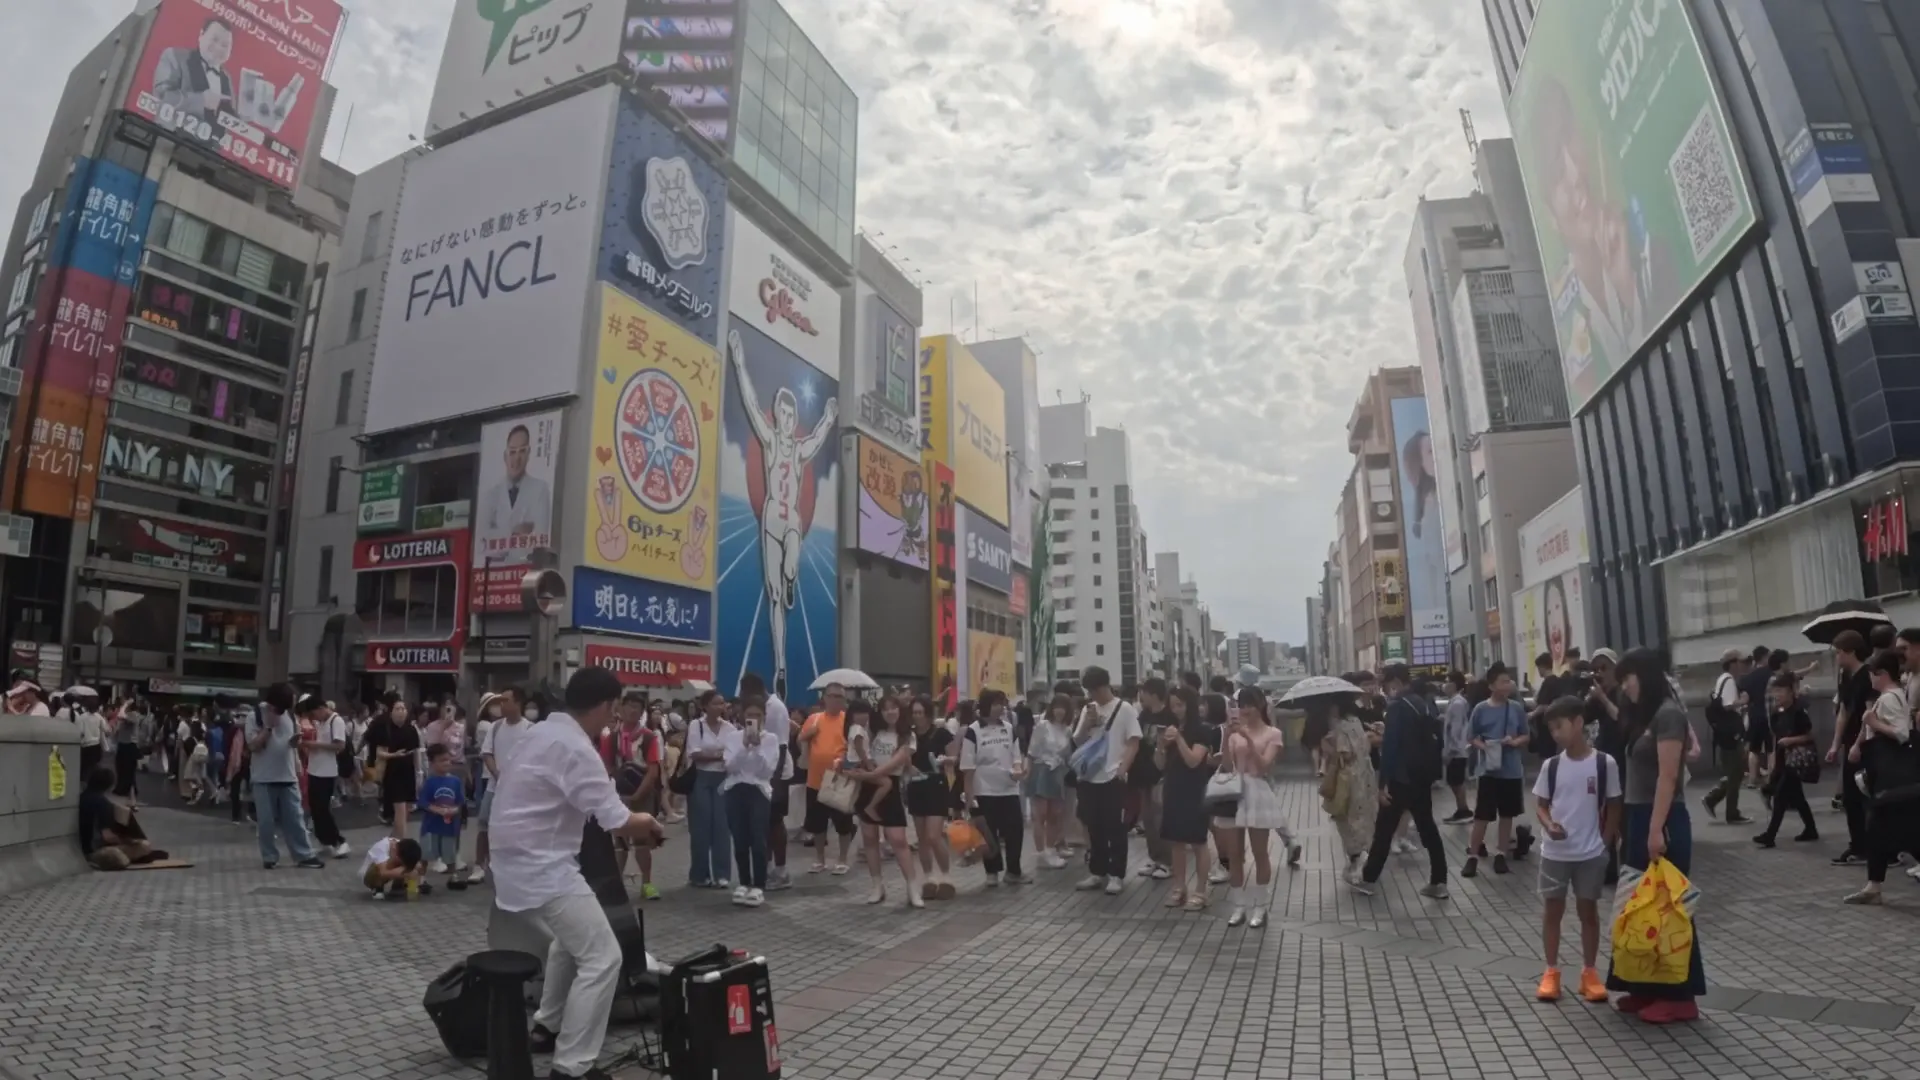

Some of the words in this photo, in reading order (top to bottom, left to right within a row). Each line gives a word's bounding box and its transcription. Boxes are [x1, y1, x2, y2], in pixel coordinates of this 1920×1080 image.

[508, 3, 593, 65] ピップ
[400, 194, 586, 265] なにげない感動をずっと。
[405, 234, 556, 322] FANCL
[625, 250, 712, 318] 雪印メグミルク
[957, 399, 1006, 468] プロミス
[778, 460, 792, 521] グリコ
[383, 539, 448, 561] LOTTERIA
[388, 647, 450, 664] LOTTERIA
[594, 655, 664, 675] LOTTERIA
